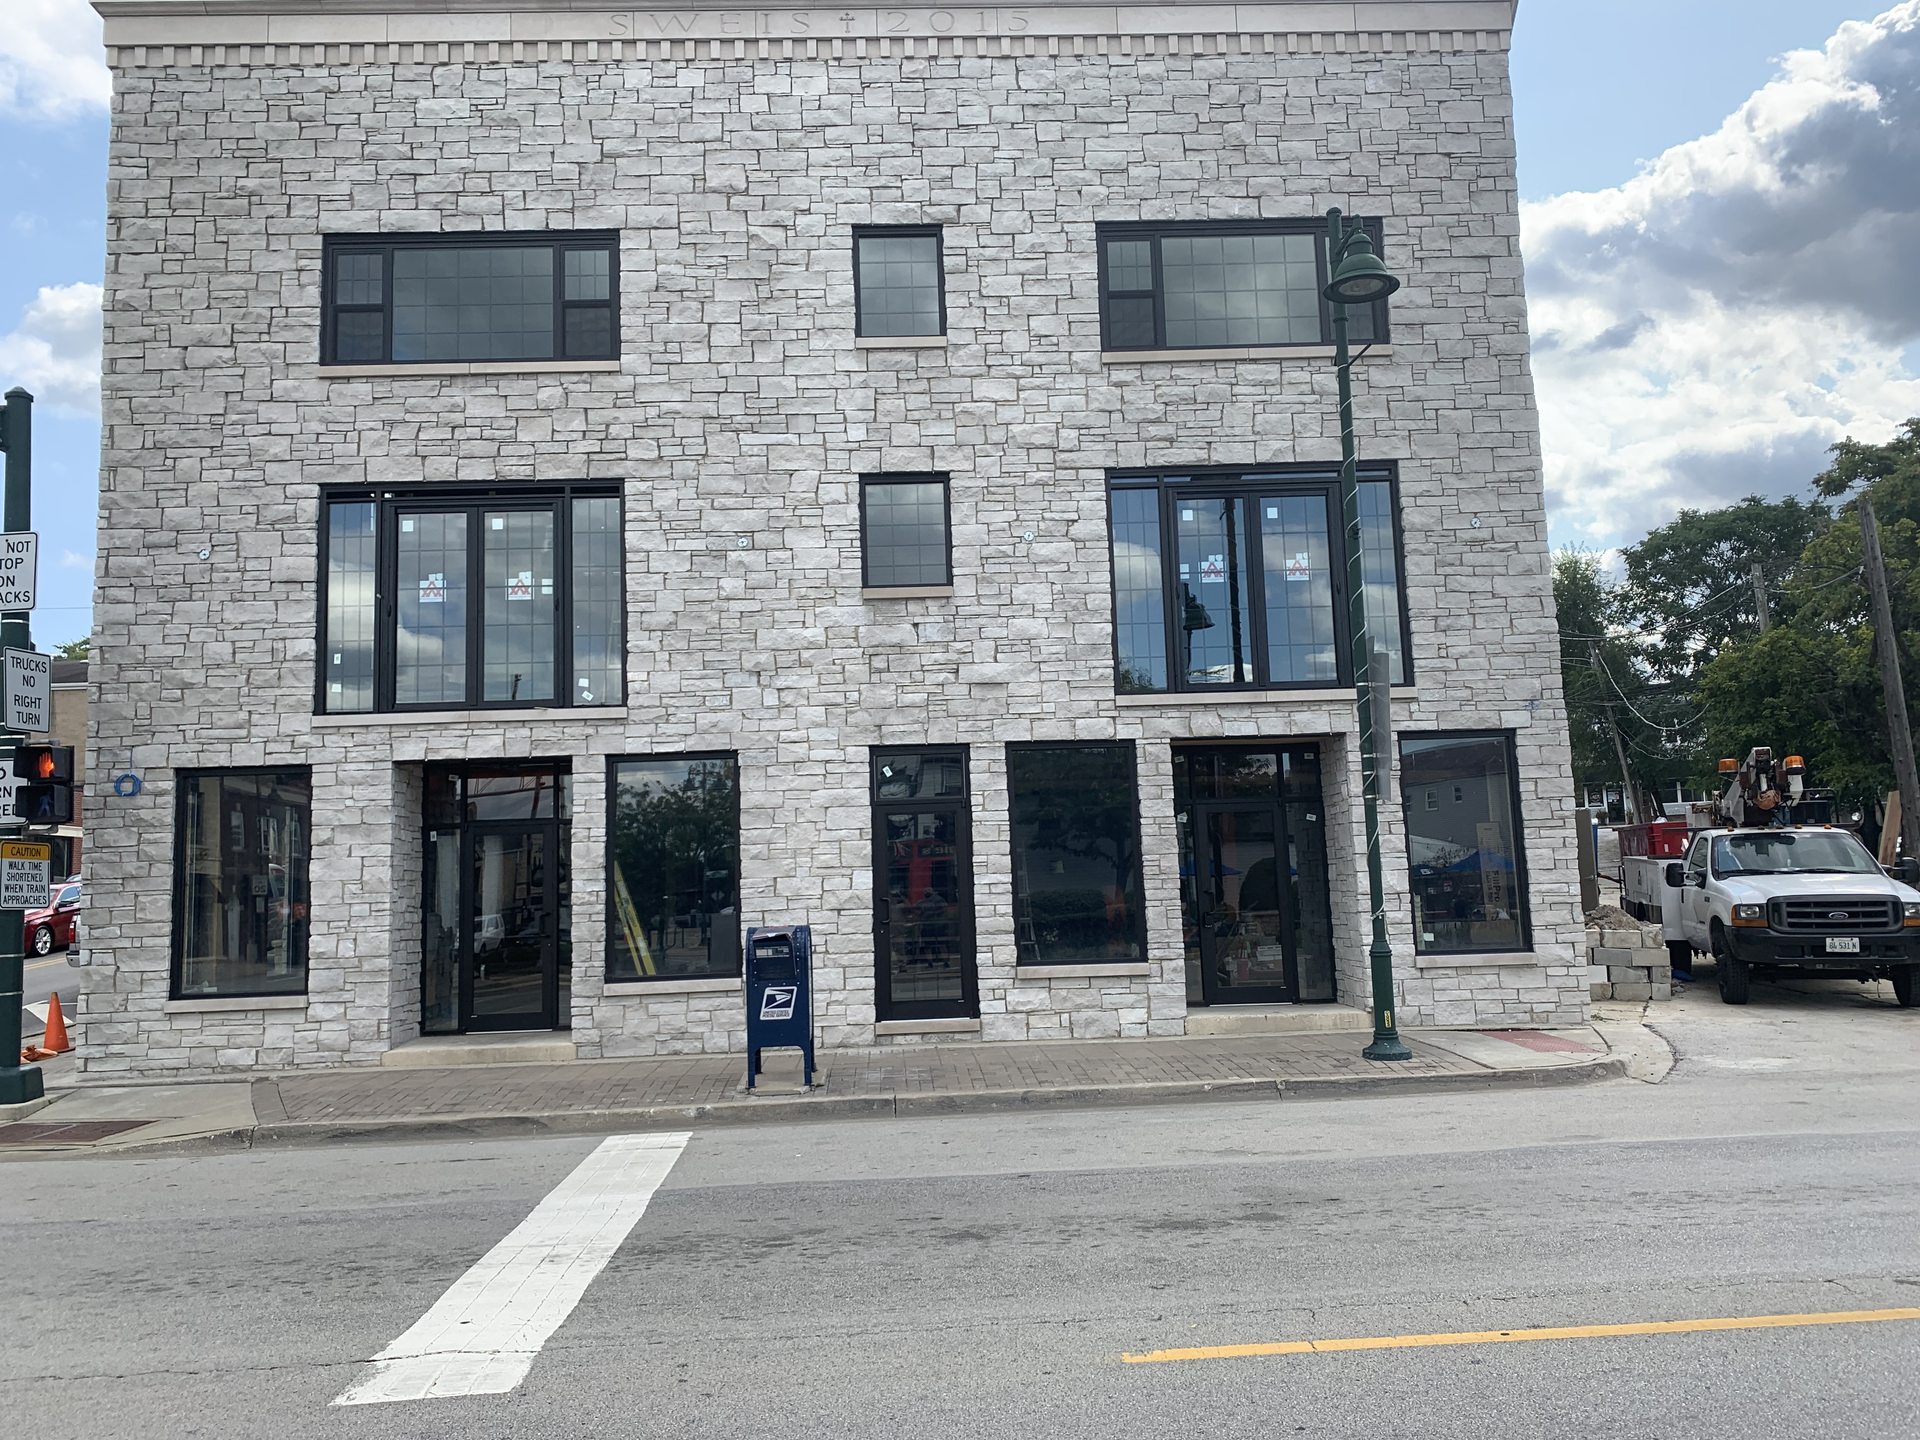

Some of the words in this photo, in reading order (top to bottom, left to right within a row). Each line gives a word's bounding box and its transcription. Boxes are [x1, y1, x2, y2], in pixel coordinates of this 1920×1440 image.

[887, 10, 1030, 32] 2015
[6, 541, 31, 553] NOT
[10, 656, 47, 673] TRUCKS
[22, 675, 36, 688] NO
[13, 694, 42, 709] RIGHT
[16, 711, 40, 725] TURN
[10, 846, 42, 857] CAUTION
[8, 861, 25, 871] WALK
[28, 861, 43, 871] TIME
[6, 872, 44, 882] SHORTENED
[4, 884, 24, 893] WHEN
[27, 884, 46, 893] TRAIN
[3, 895, 47, 905] APPROACHES
